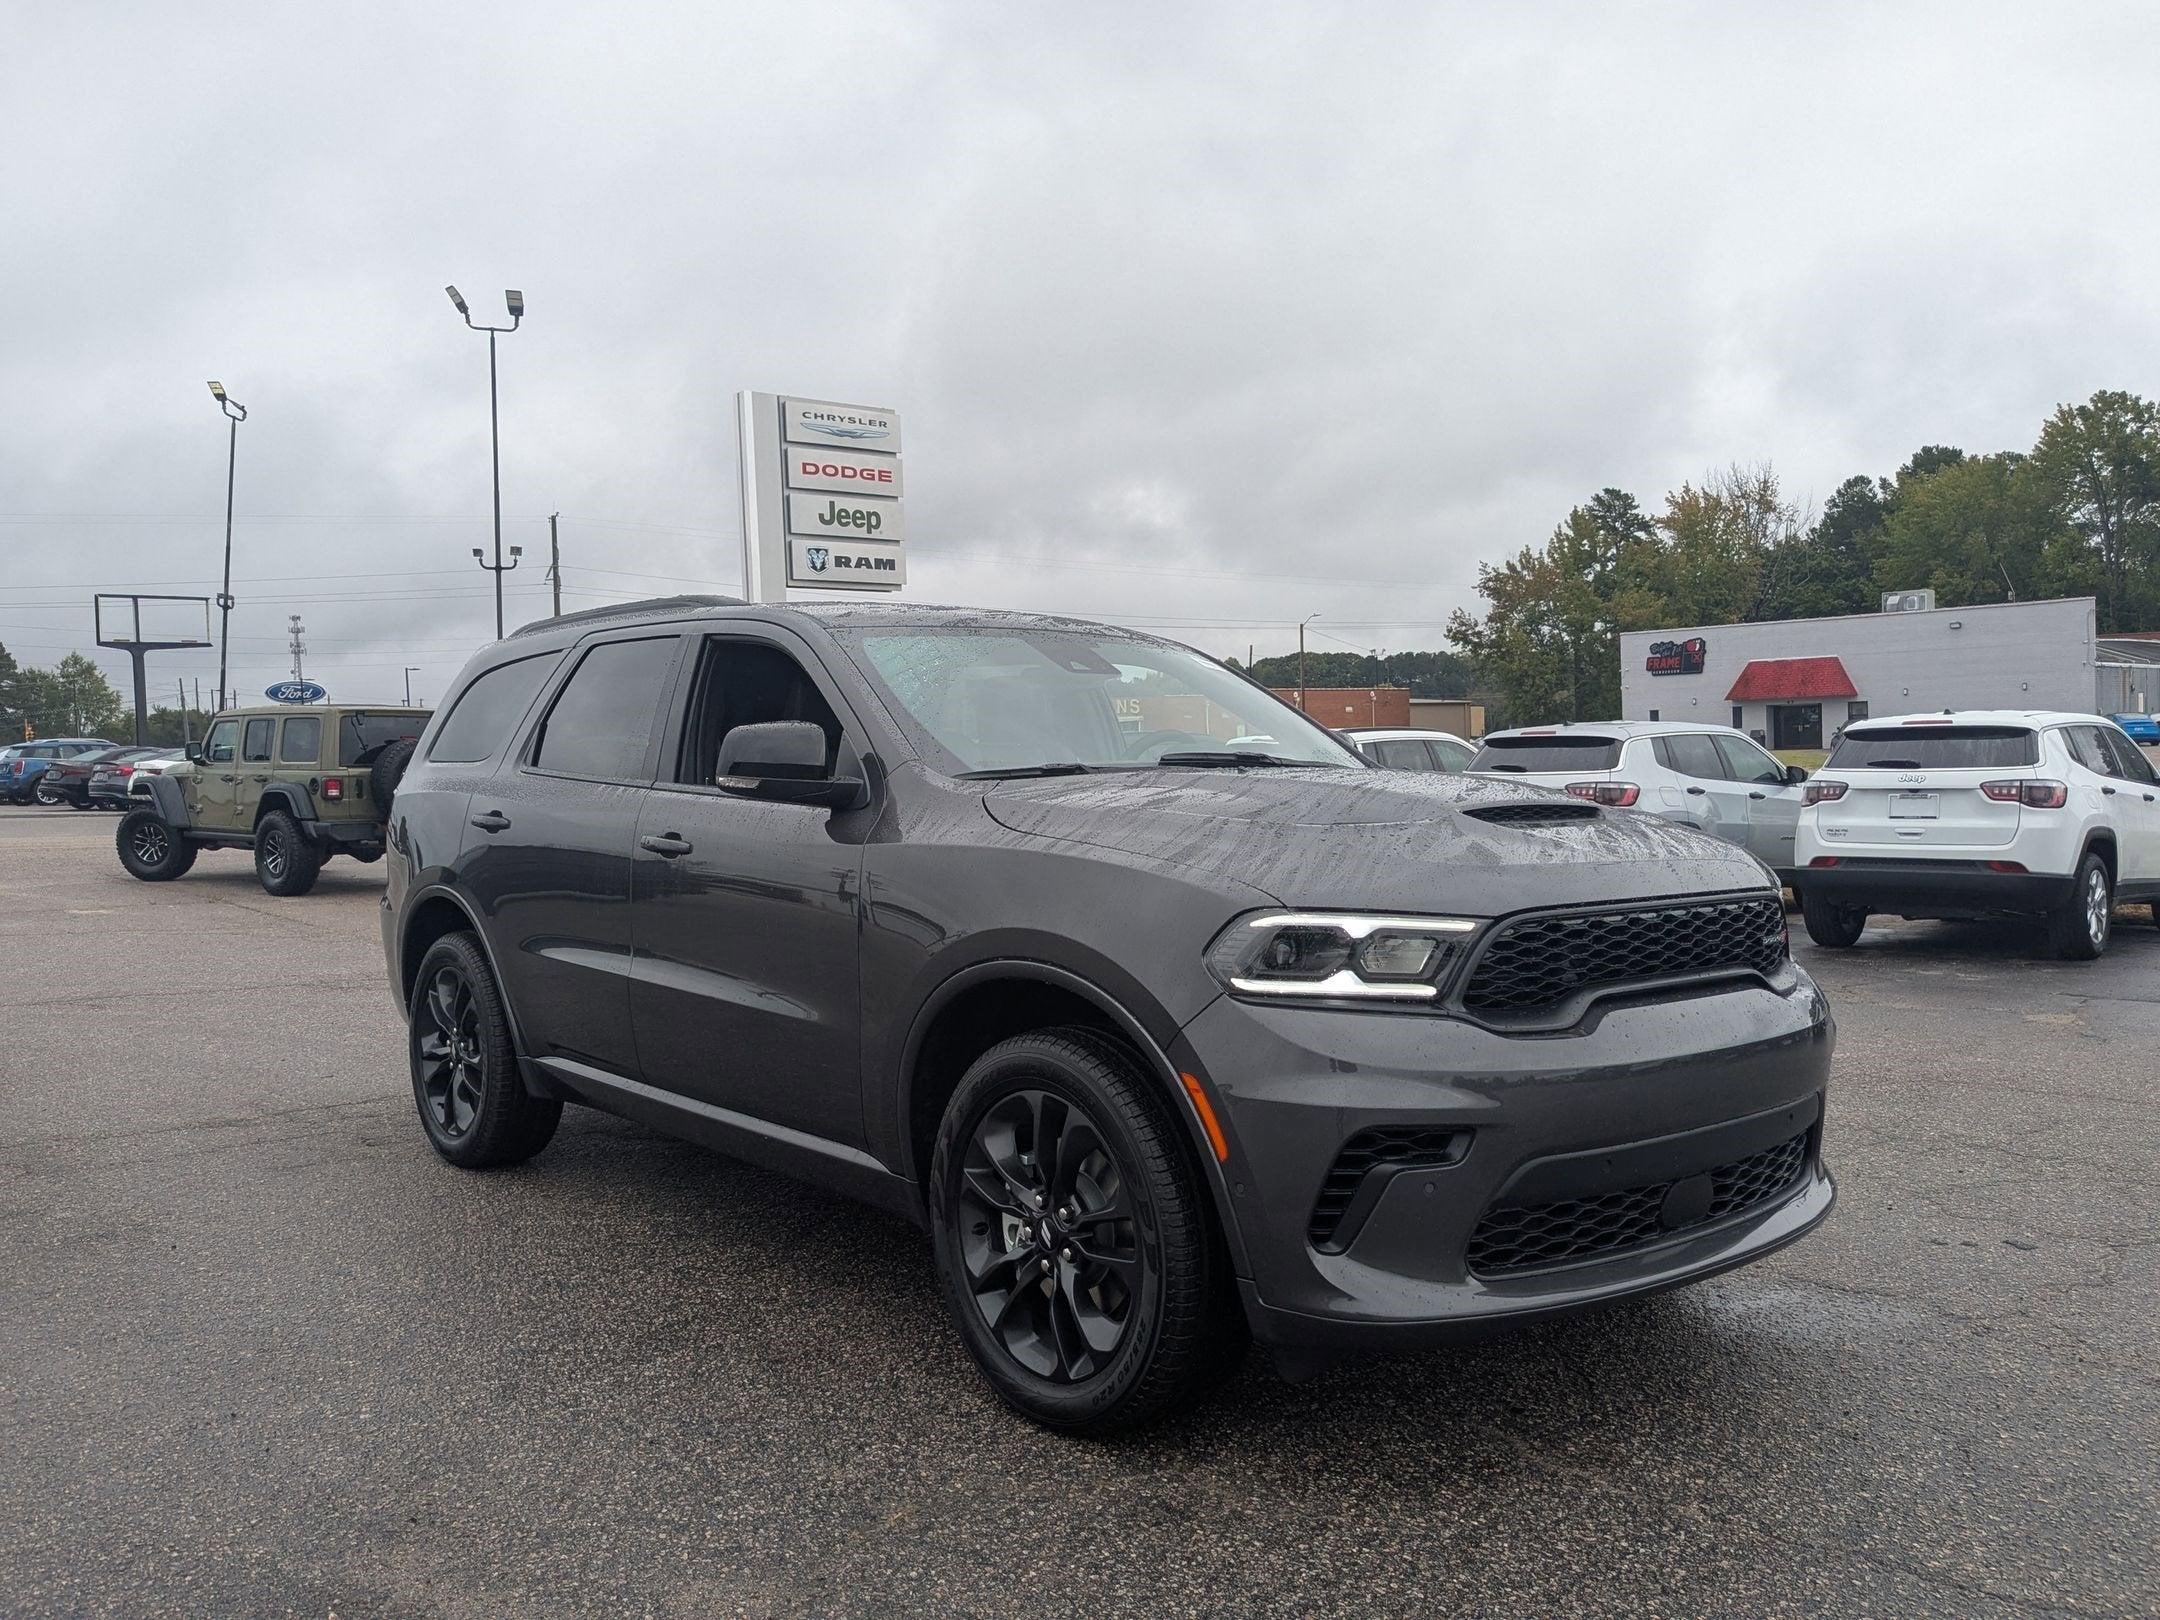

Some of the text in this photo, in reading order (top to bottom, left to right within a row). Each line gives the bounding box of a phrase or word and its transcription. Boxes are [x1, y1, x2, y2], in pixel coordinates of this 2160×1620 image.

[802, 411, 888, 428] CHRYSLER
[802, 462, 893, 483] DODGE
[818, 500, 882, 534] Jeep
[834, 555, 896, 571] RAM
[1647, 657, 1681, 669] FRAME
[278, 685, 314, 699] Ford
[1898, 773, 1926, 784] Jeep
